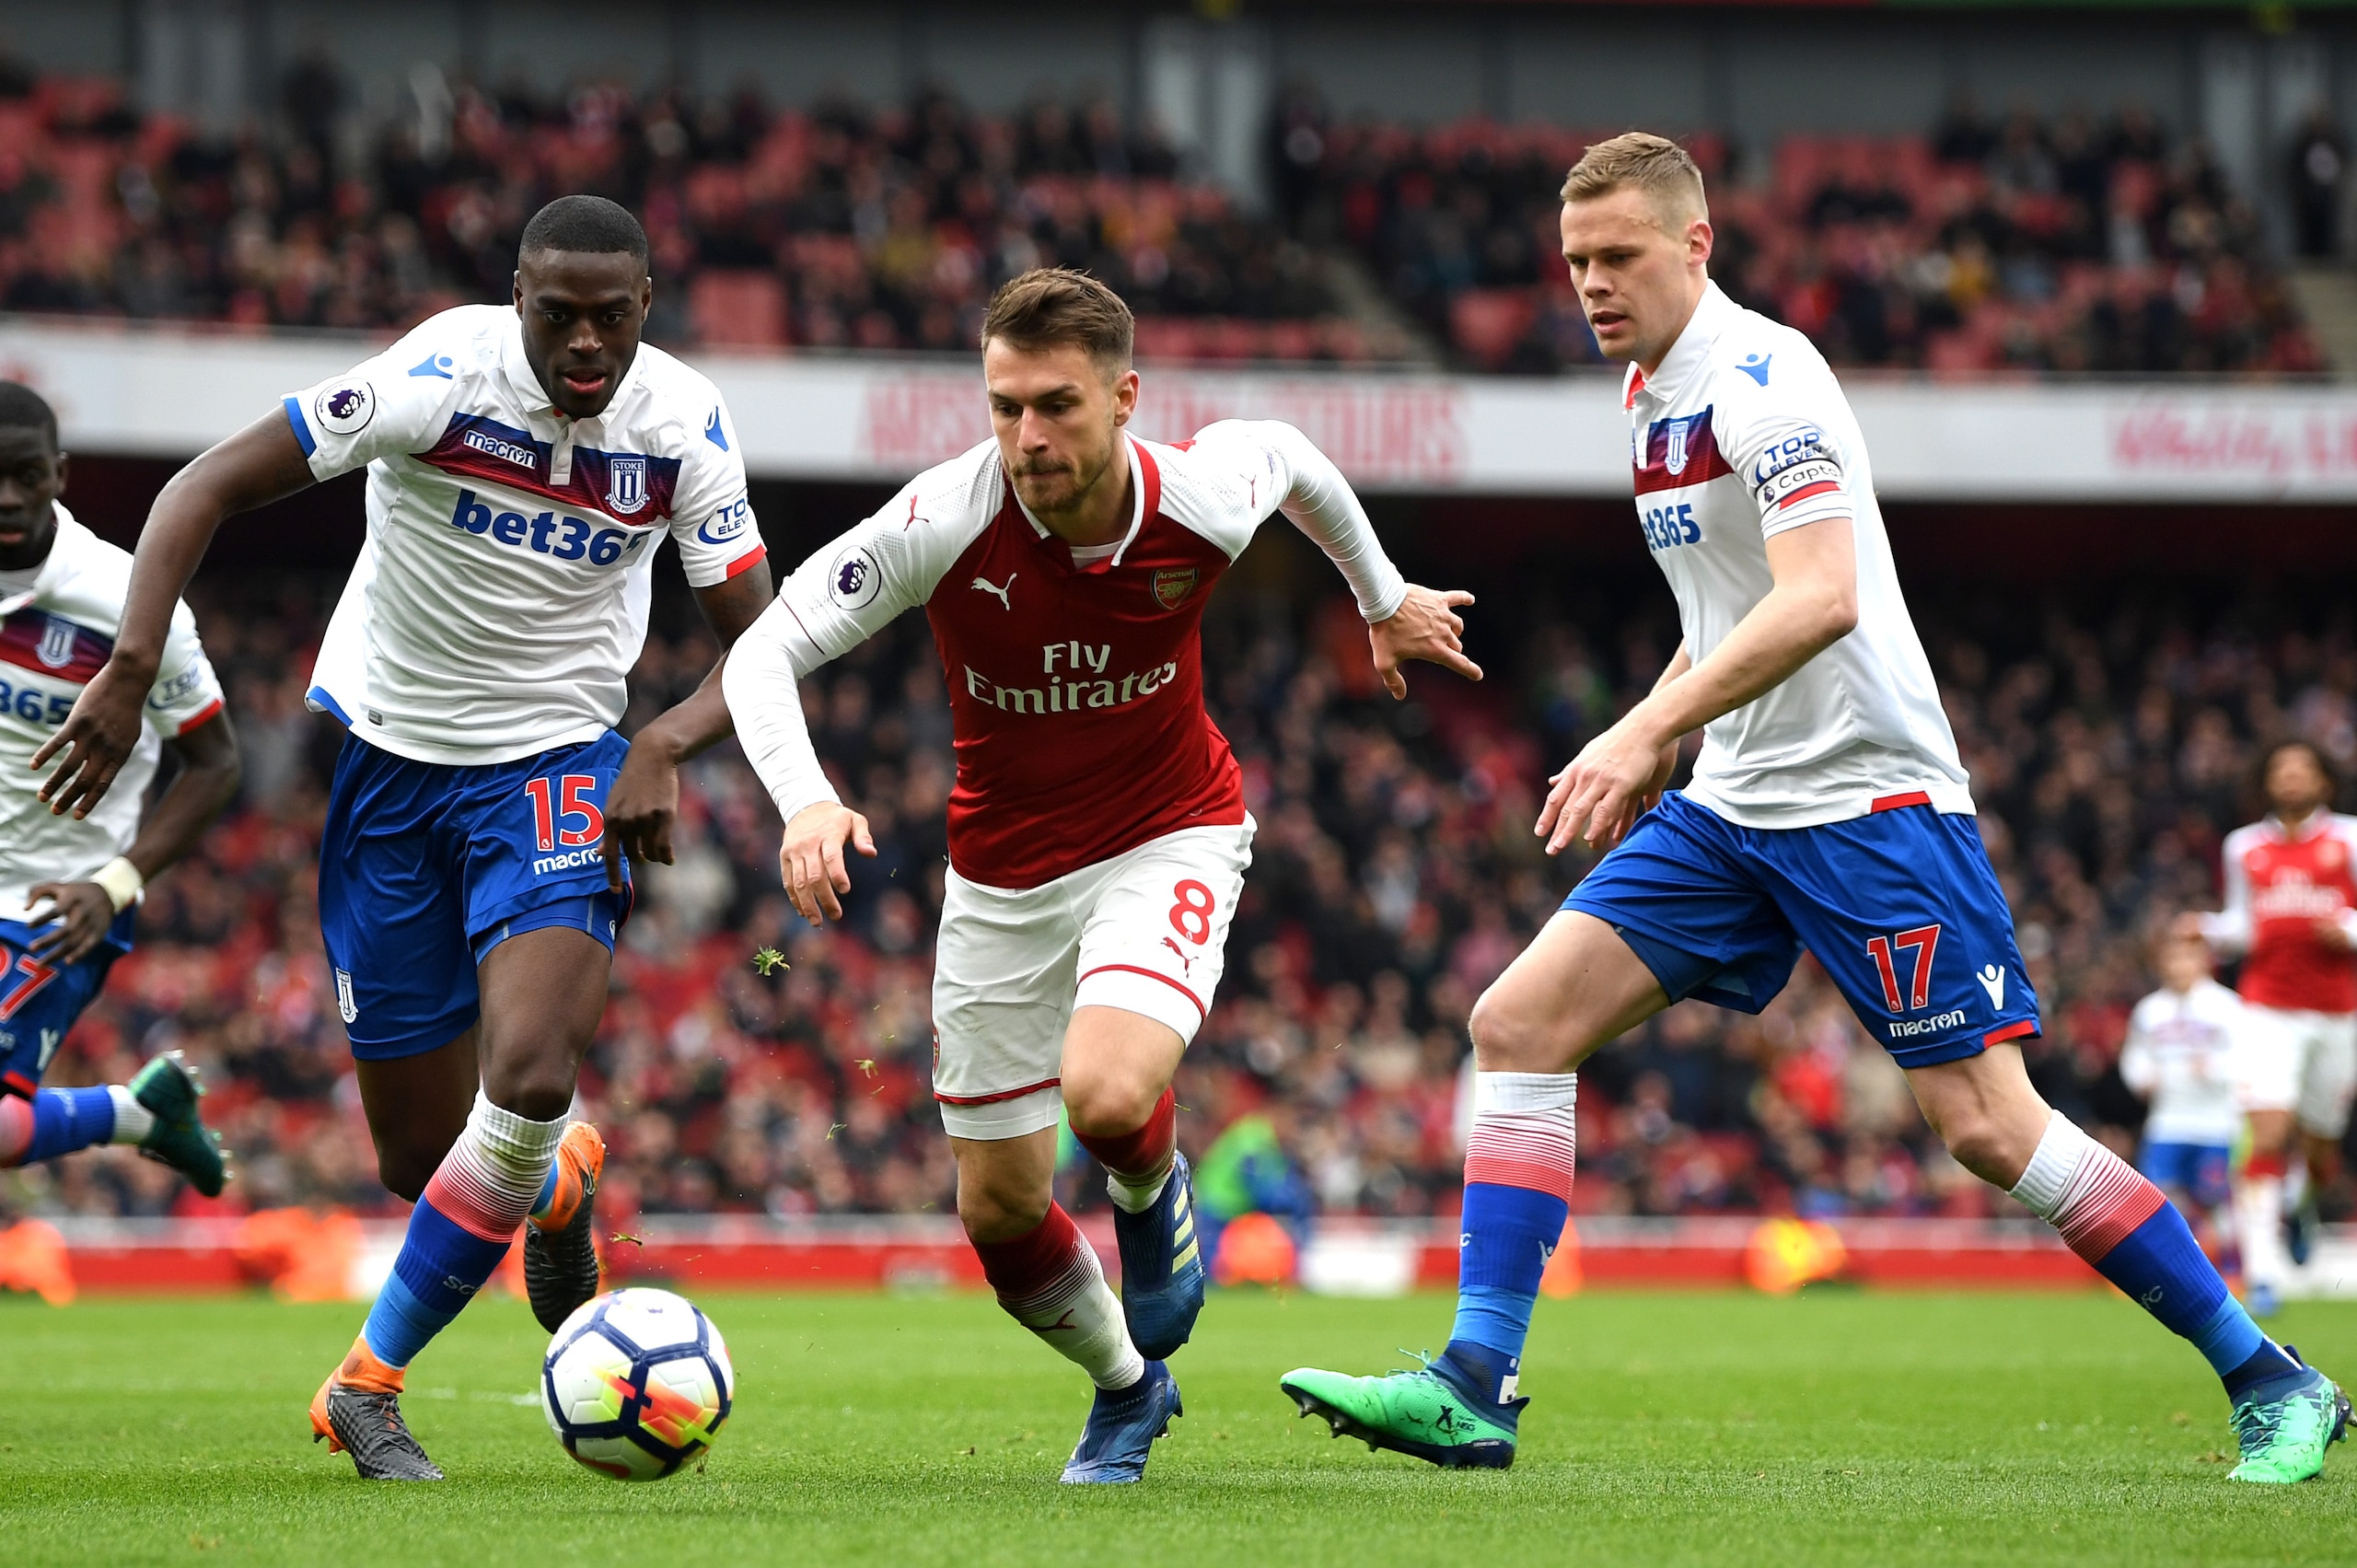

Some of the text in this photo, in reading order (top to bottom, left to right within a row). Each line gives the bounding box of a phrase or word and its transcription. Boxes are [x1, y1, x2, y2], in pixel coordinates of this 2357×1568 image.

[465, 431, 537, 469] macron
[1764, 433, 1820, 462] TOP
[614, 461, 643, 470] STOKE
[1157, 568, 1192, 579] Arsenal
[1043, 641, 1110, 673] Fly
[963, 663, 1177, 714] Emirates
[525, 774, 605, 851] 15
[1169, 879, 1215, 946] 8
[1867, 923, 1941, 1013] 17
[1888, 1009, 1966, 1038] macron
